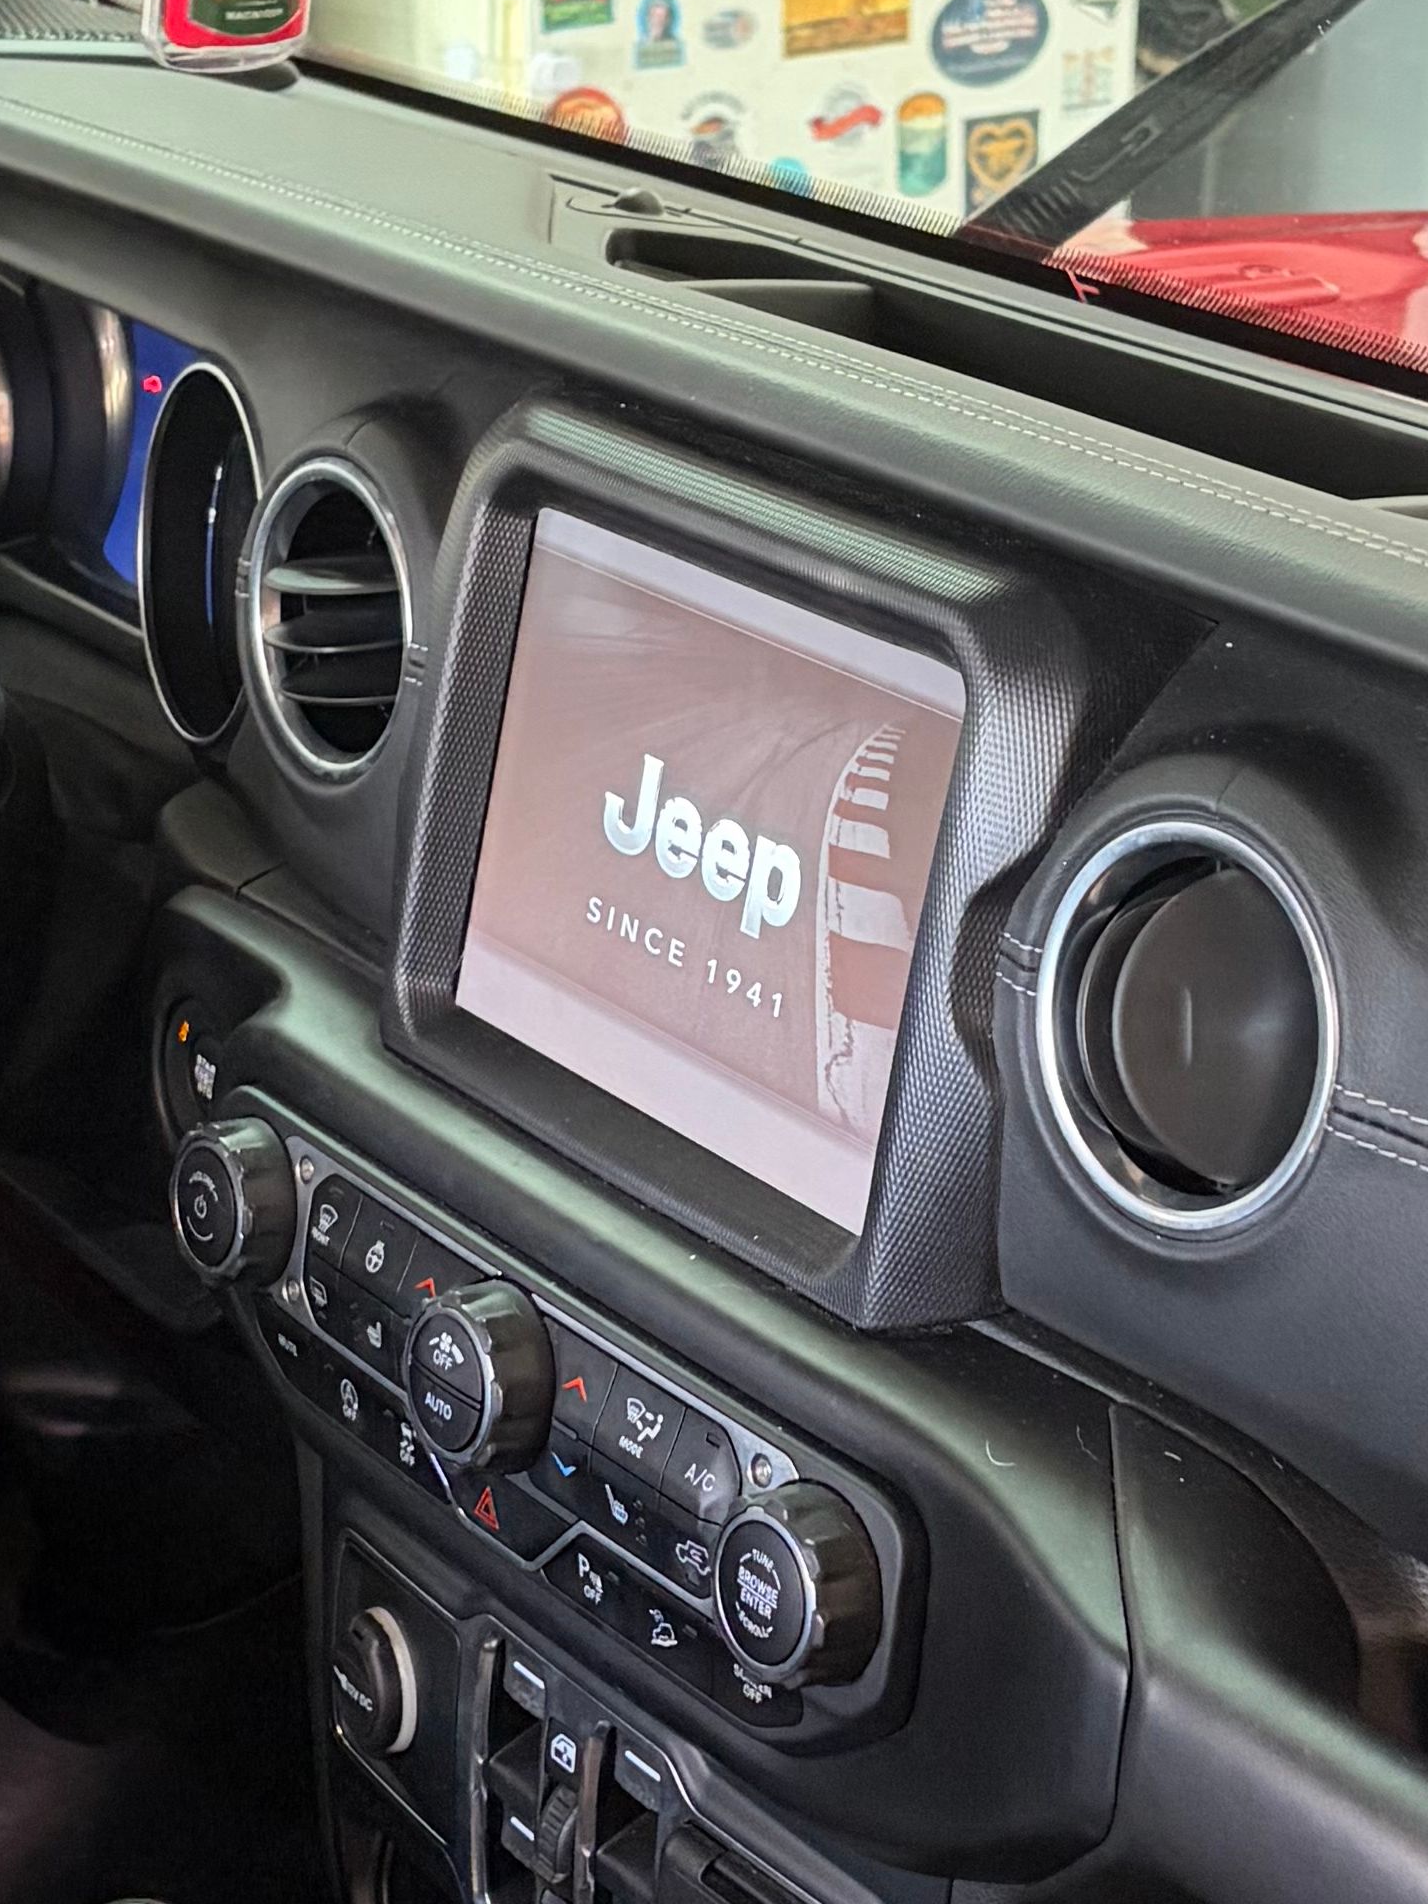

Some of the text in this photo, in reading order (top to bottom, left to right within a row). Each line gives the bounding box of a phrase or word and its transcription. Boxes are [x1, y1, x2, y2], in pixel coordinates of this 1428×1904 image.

[602, 752, 803, 940] Jeep
[584, 894, 785, 1020] SINCE 1941
[432, 1351, 453, 1371] OFF
[424, 1391, 453, 1421] AUTO
[618, 1435, 644, 1460] MODE
[684, 1462, 716, 1493] A/C
[737, 1564, 779, 1602] BROWSE
[740, 1585, 773, 1621] ENTER
